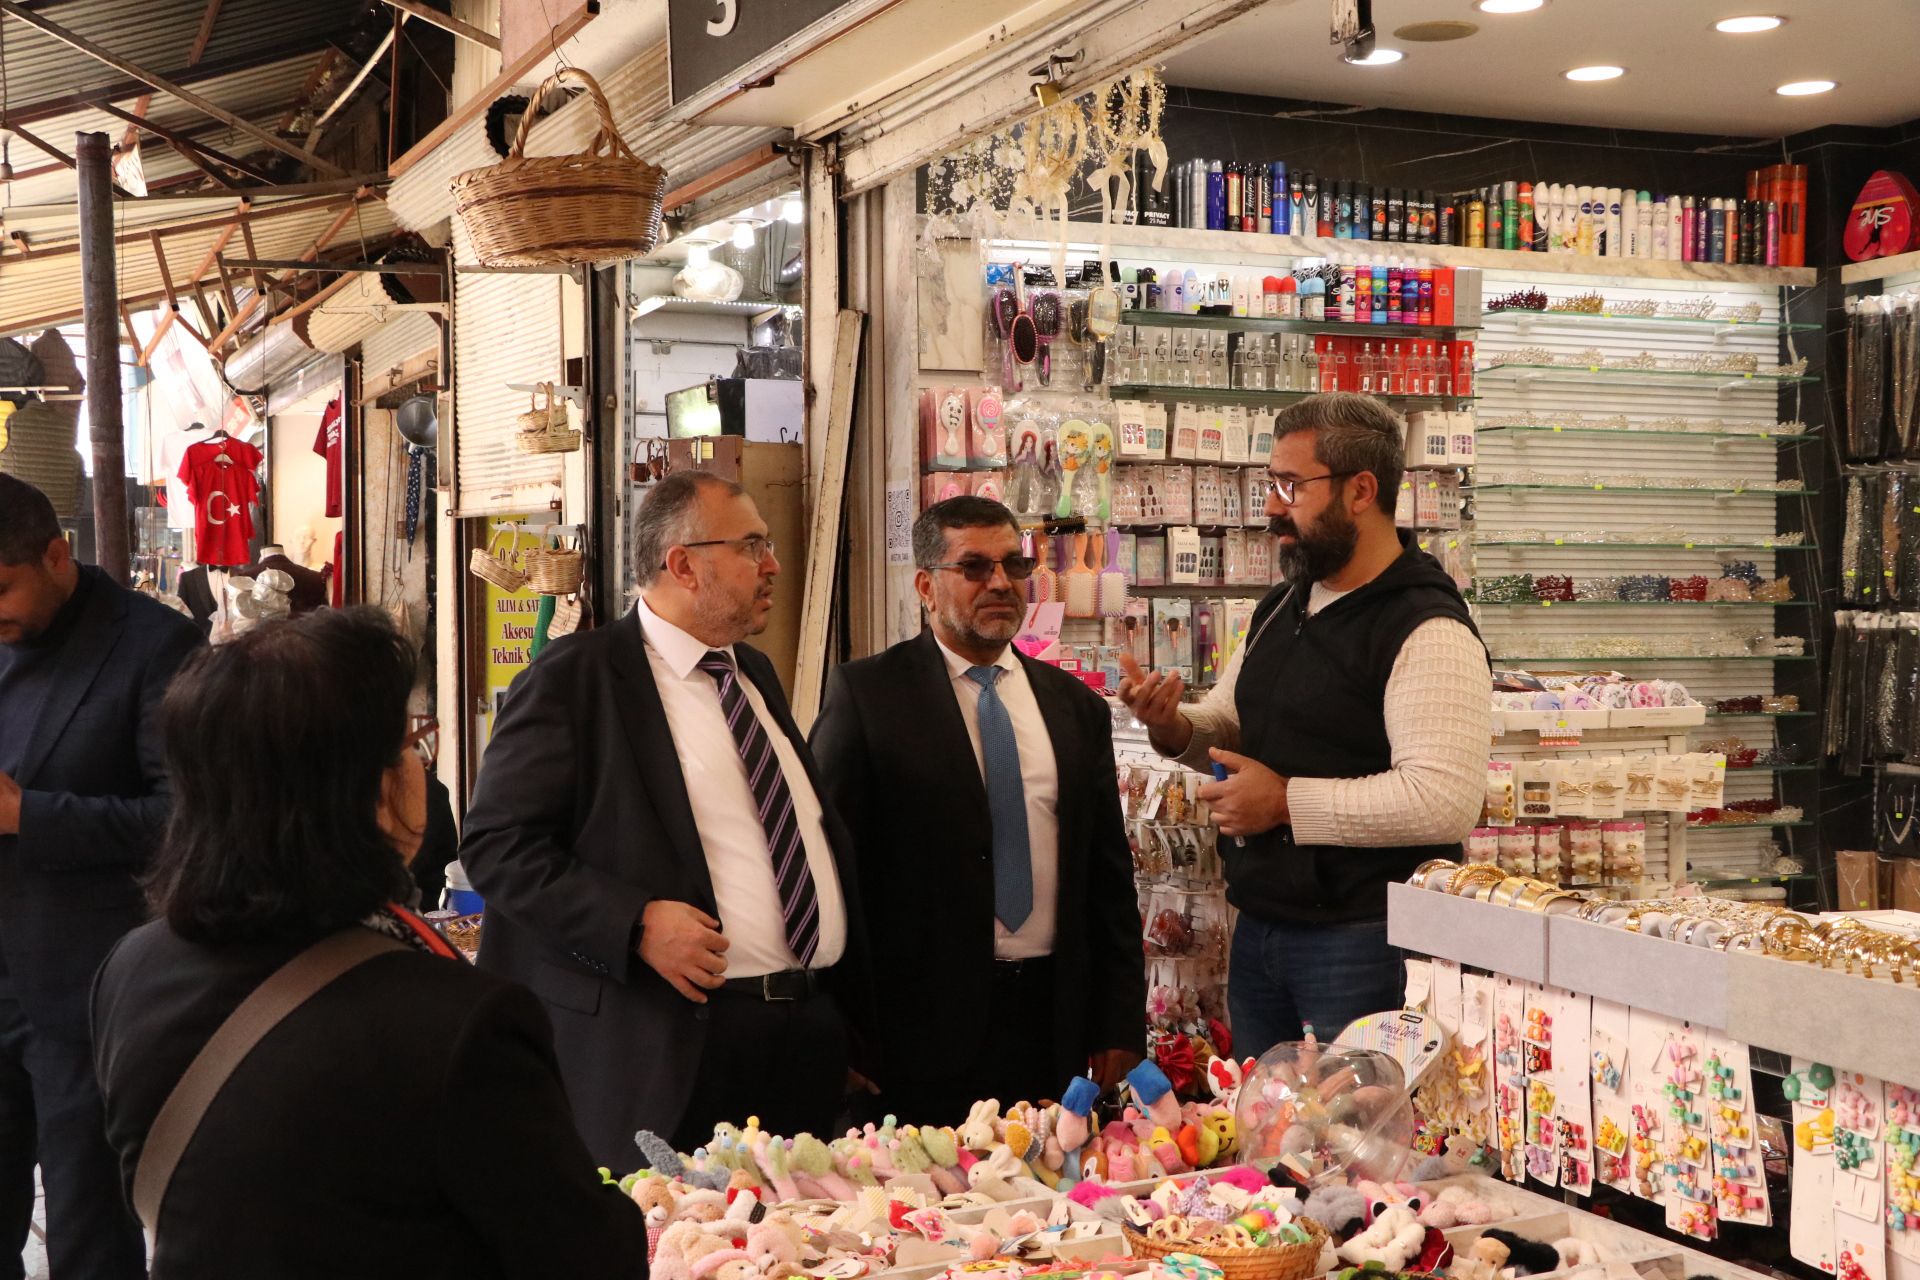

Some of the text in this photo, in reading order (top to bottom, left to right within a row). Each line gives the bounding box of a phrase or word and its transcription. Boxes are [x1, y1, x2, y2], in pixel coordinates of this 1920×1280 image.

[1143, 211, 1170, 221] PRIVACY
[1323, 196, 1331, 222] BLADE
[1353, 198, 1361, 224] BLADE
[496, 600, 516, 613] ALIM
[519, 600, 524, 613] &
[492, 647, 524, 664] Teknik
